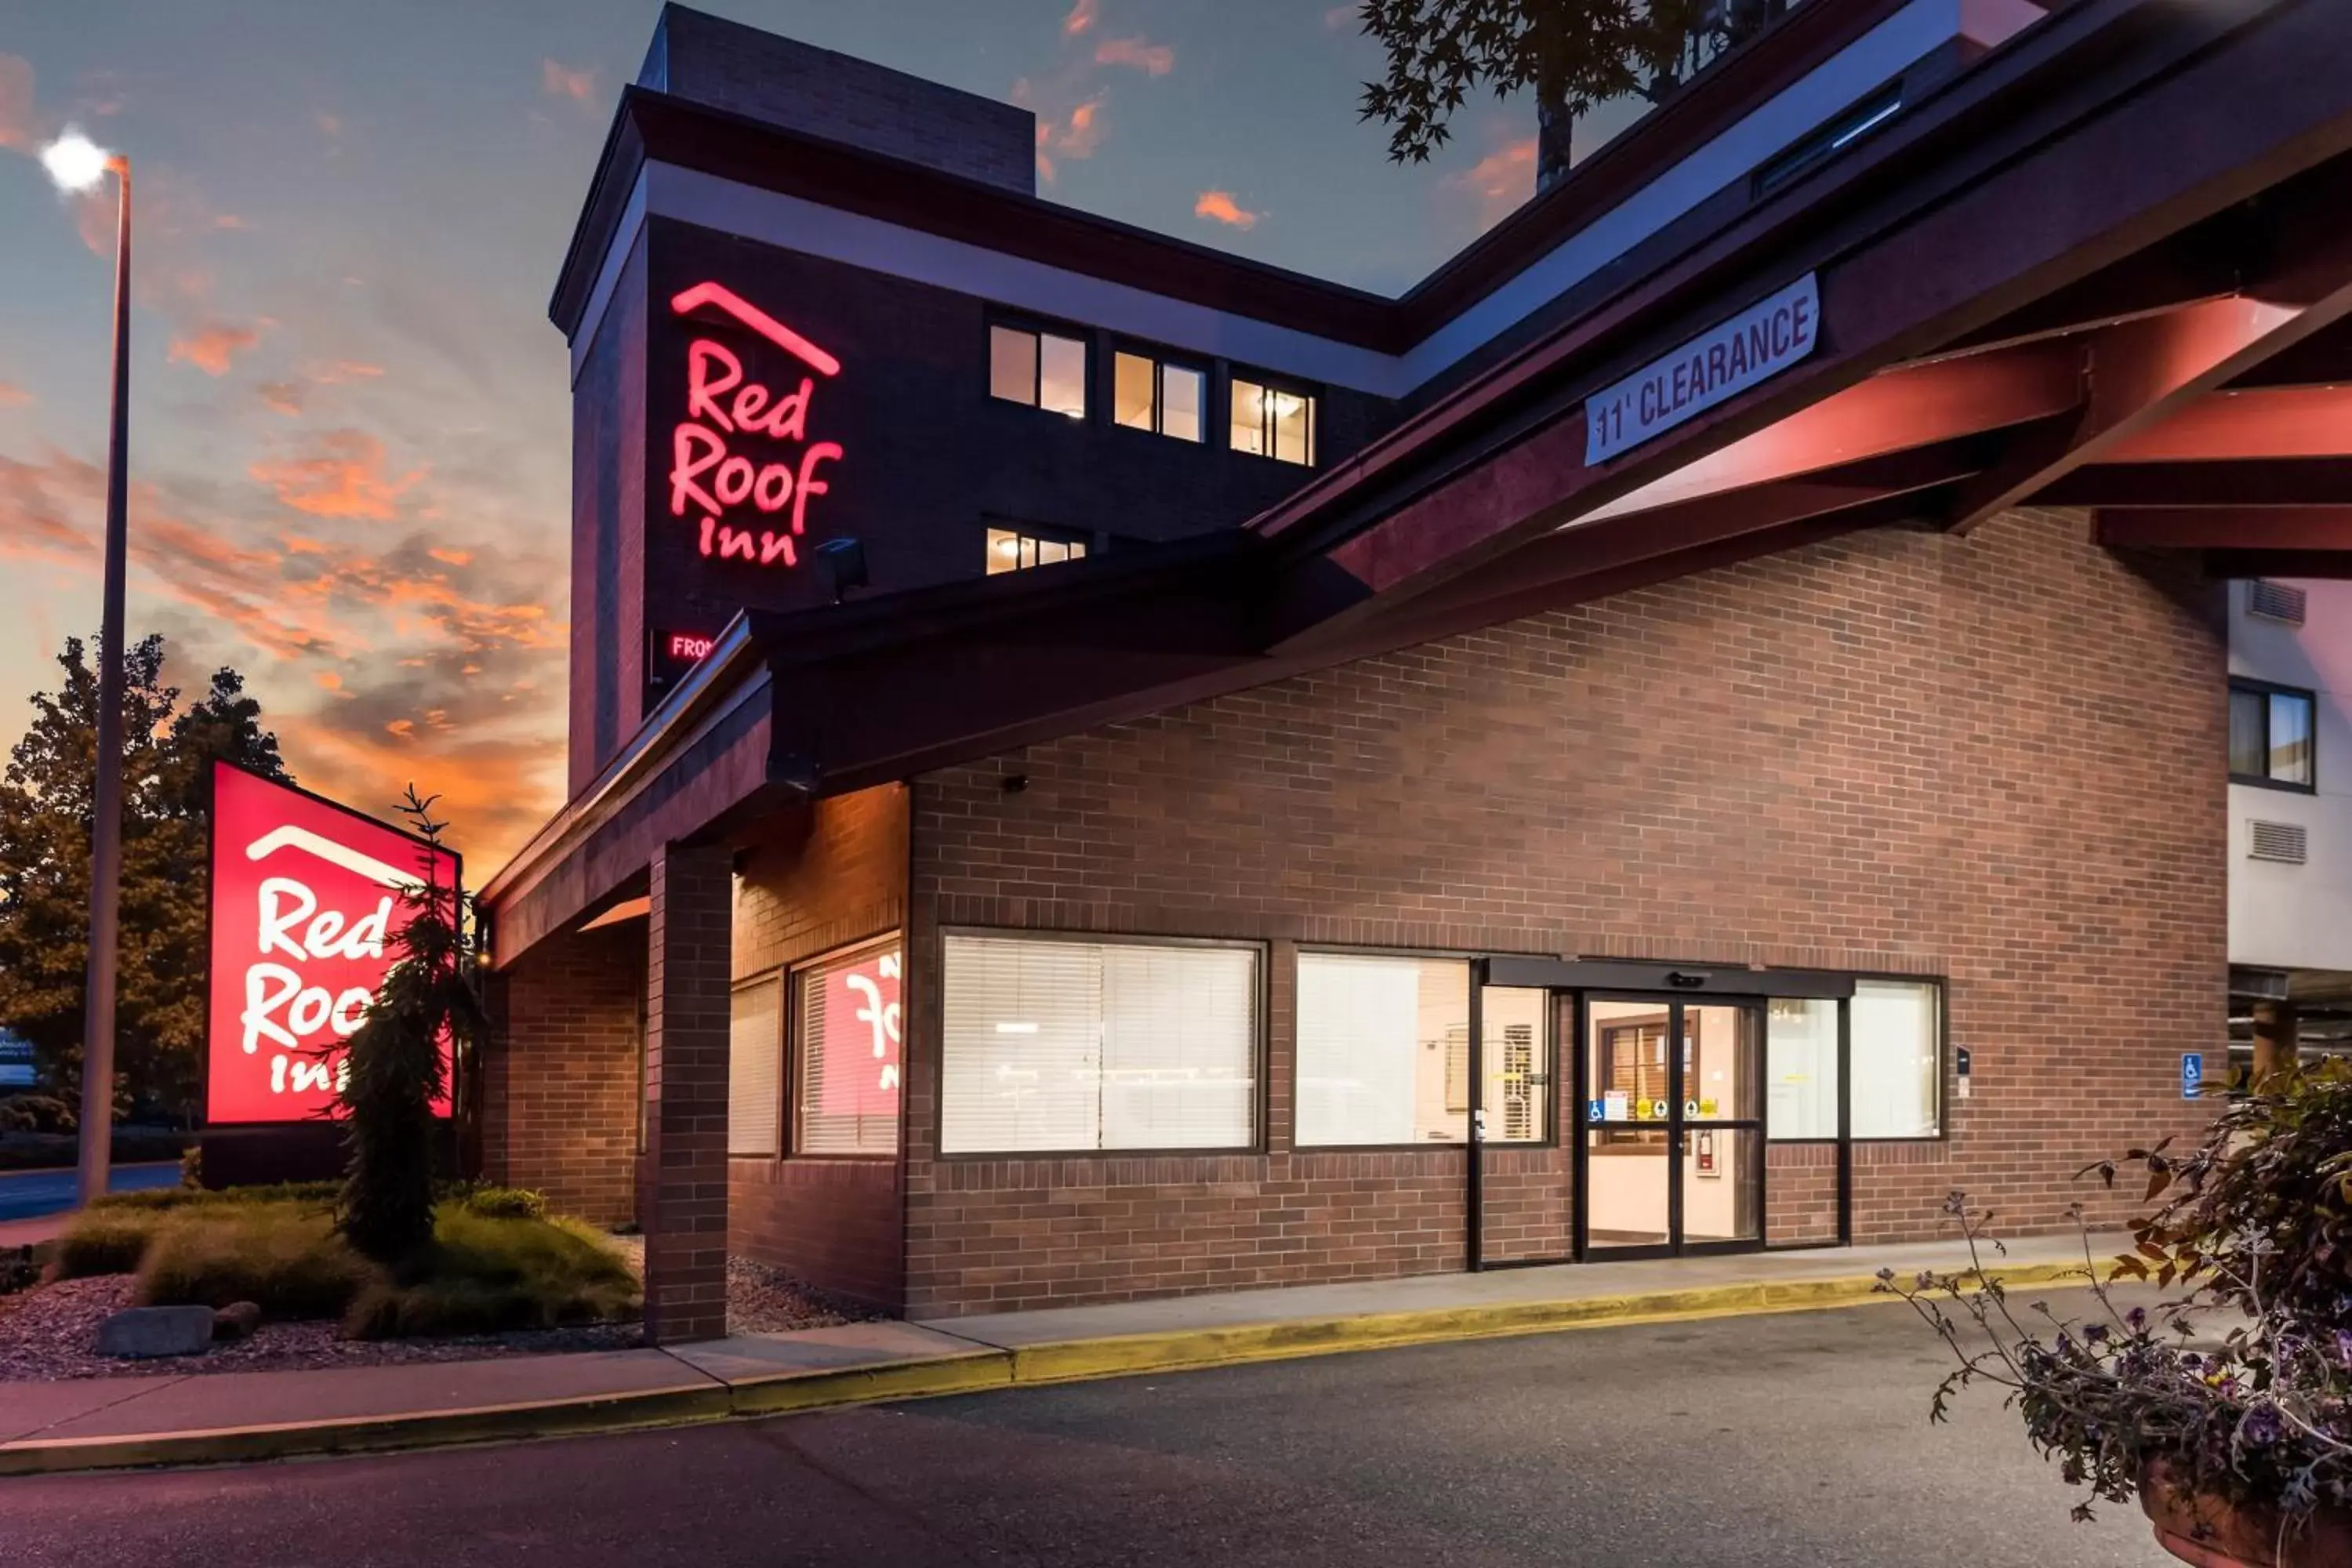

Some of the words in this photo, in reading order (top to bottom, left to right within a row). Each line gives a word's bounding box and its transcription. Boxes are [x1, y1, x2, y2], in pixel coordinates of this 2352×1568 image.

[687, 338, 814, 441] Red
[1639, 296, 1809, 427] CLEARANCE
[670, 423, 844, 535] Roof
[258, 877, 394, 962] Red
[240, 956, 416, 1054] Roo
